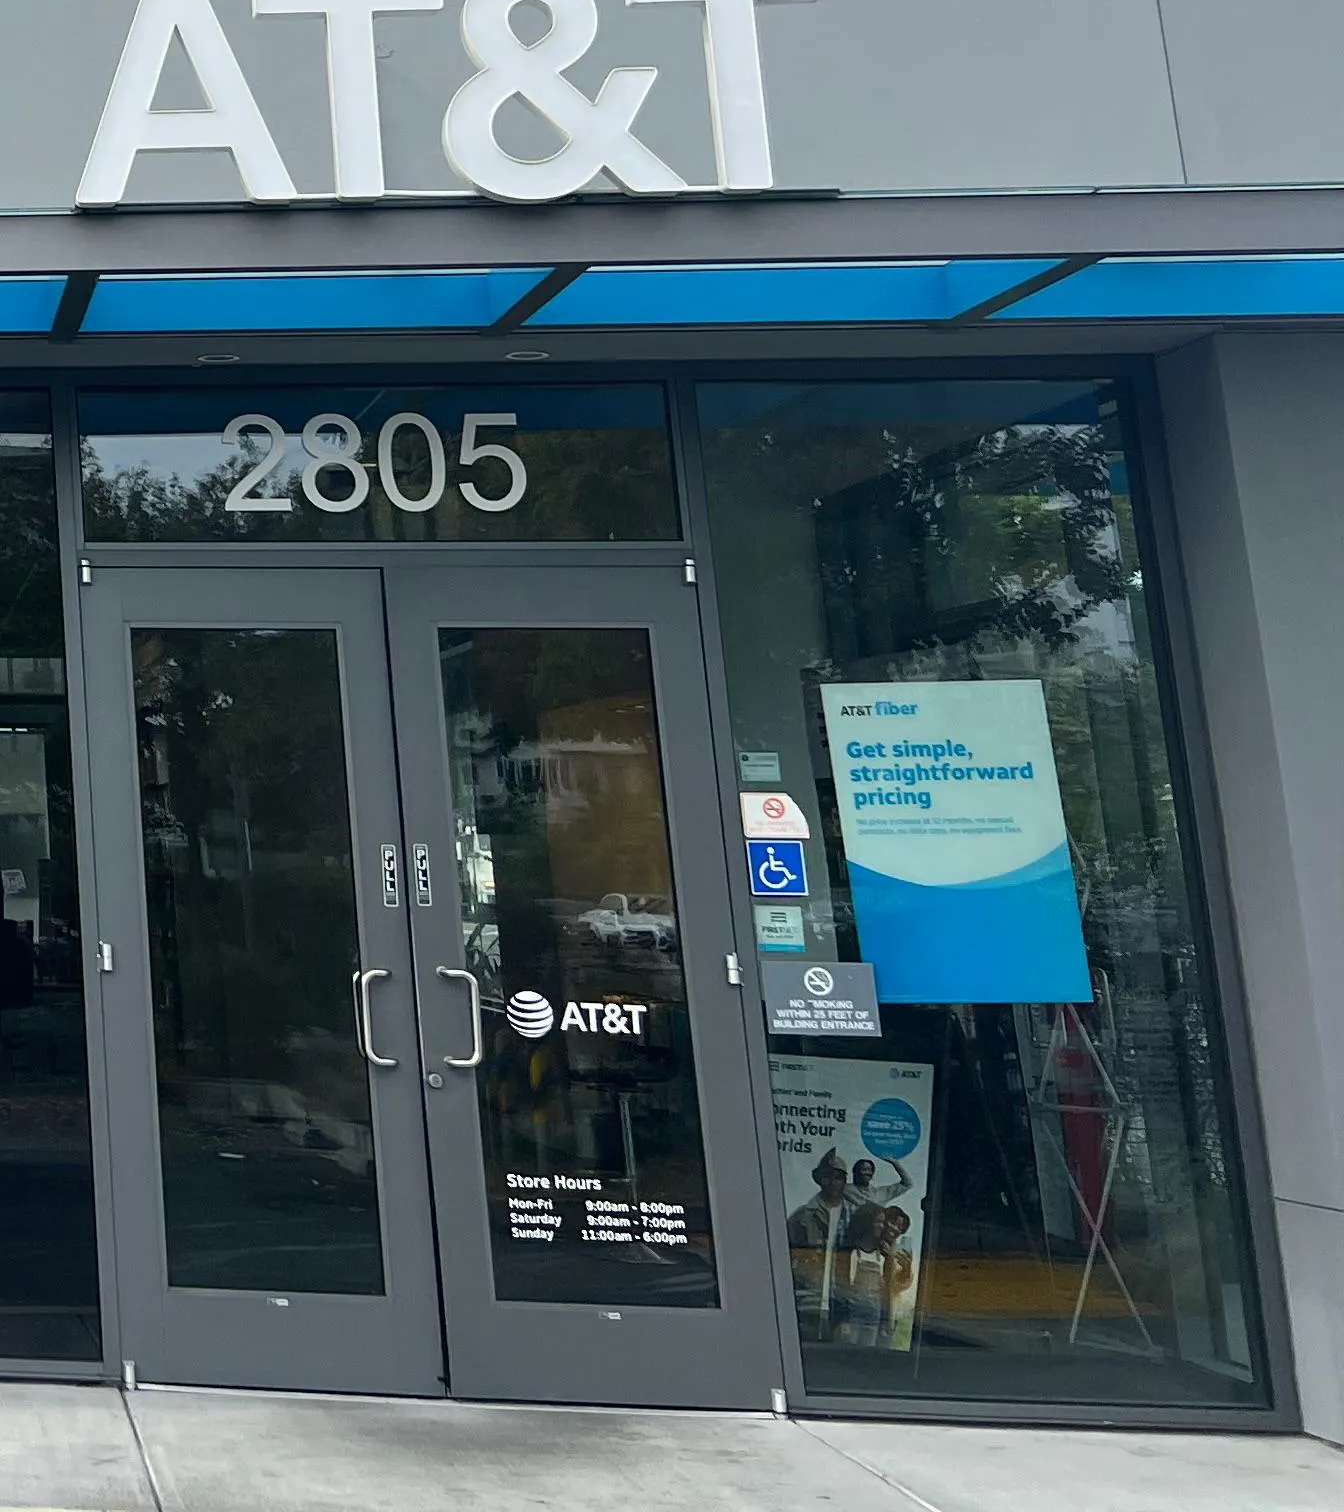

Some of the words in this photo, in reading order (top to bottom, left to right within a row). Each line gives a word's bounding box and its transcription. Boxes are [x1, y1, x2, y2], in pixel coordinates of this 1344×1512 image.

[221, 411, 529, 514] 2805
[840, 705, 872, 717] AT&T
[875, 701, 918, 716] fiber
[846, 741, 887, 759] Get
[892, 739, 973, 762] simple,
[849, 761, 1034, 786] straightforward
[853, 786, 932, 810] pricing
[384, 850, 395, 892] PULL
[416, 849, 428, 891] PULL
[789, 999, 805, 1008] NO
[560, 1001, 648, 1035] AT&T
[775, 1009, 811, 1019] WITHIN
[813, 1009, 826, 1020] 25
[828, 1010, 852, 1020] FEET
[855, 1010, 869, 1020] OF
[773, 1019, 818, 1029] BUILDING
[821, 1020, 875, 1031] ENTRANCE
[901, 1070, 922, 1079] AT&T
[773, 1103, 847, 1123] onnecting
[800, 1121, 836, 1138] Your
[506, 1173, 551, 1189] Store
[554, 1175, 602, 1190] Hours
[508, 1198, 554, 1210] Mon-Fri
[584, 1200, 630, 1213] 9:00am
[509, 1212, 562, 1227] Saturday
[586, 1214, 631, 1227] 9:00am
[641, 1216, 686, 1231] 7:00pm
[511, 1227, 555, 1242] Sunday
[581, 1229, 633, 1242] 11:00am
